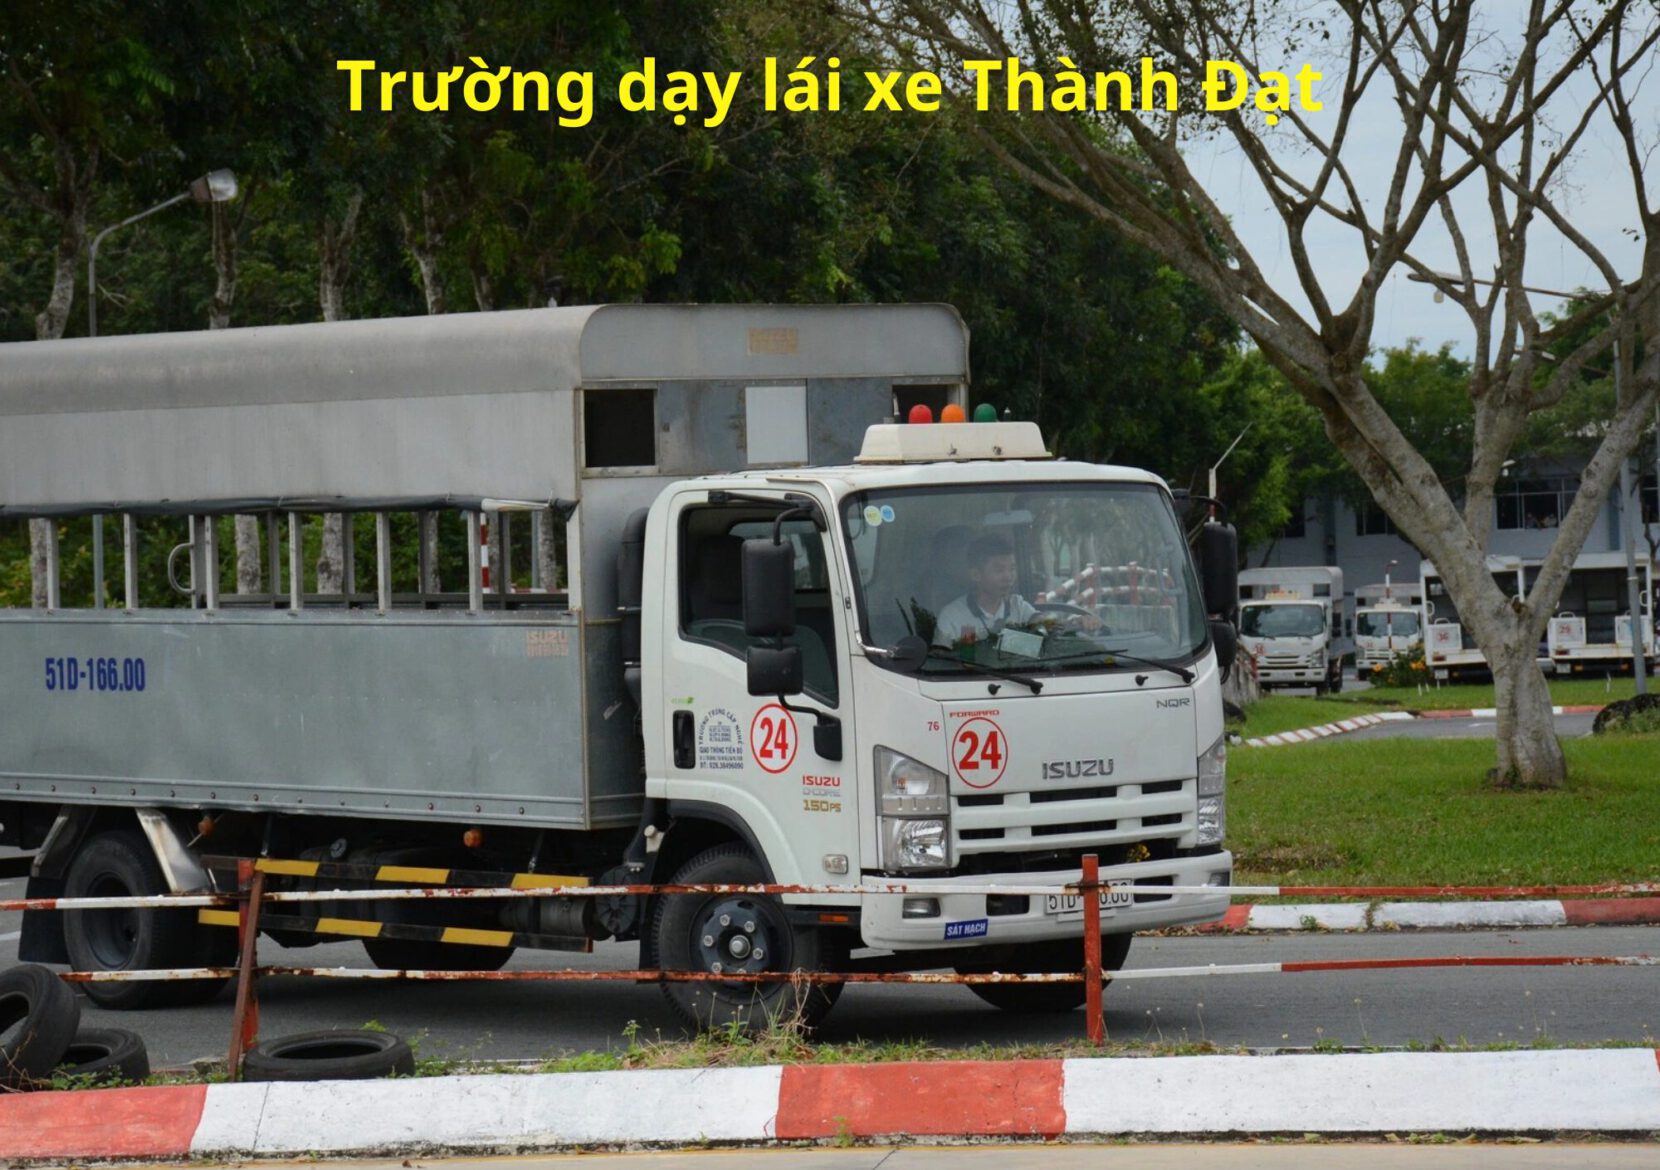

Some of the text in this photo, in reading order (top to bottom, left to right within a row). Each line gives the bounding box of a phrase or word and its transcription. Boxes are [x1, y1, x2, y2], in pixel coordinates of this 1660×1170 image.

[44, 657, 146, 692] 51D-166.00
[1156, 697, 1190, 709] NQR
[949, 709, 1000, 718] FORWARD
[927, 720, 940, 732] 76
[759, 716, 789, 760] 24
[958, 730, 1002, 770] 24
[1042, 758, 1114, 780] ISUZU
[802, 775, 841, 787] ISUZU
[946, 922, 986, 937] SÁT HẠCH
